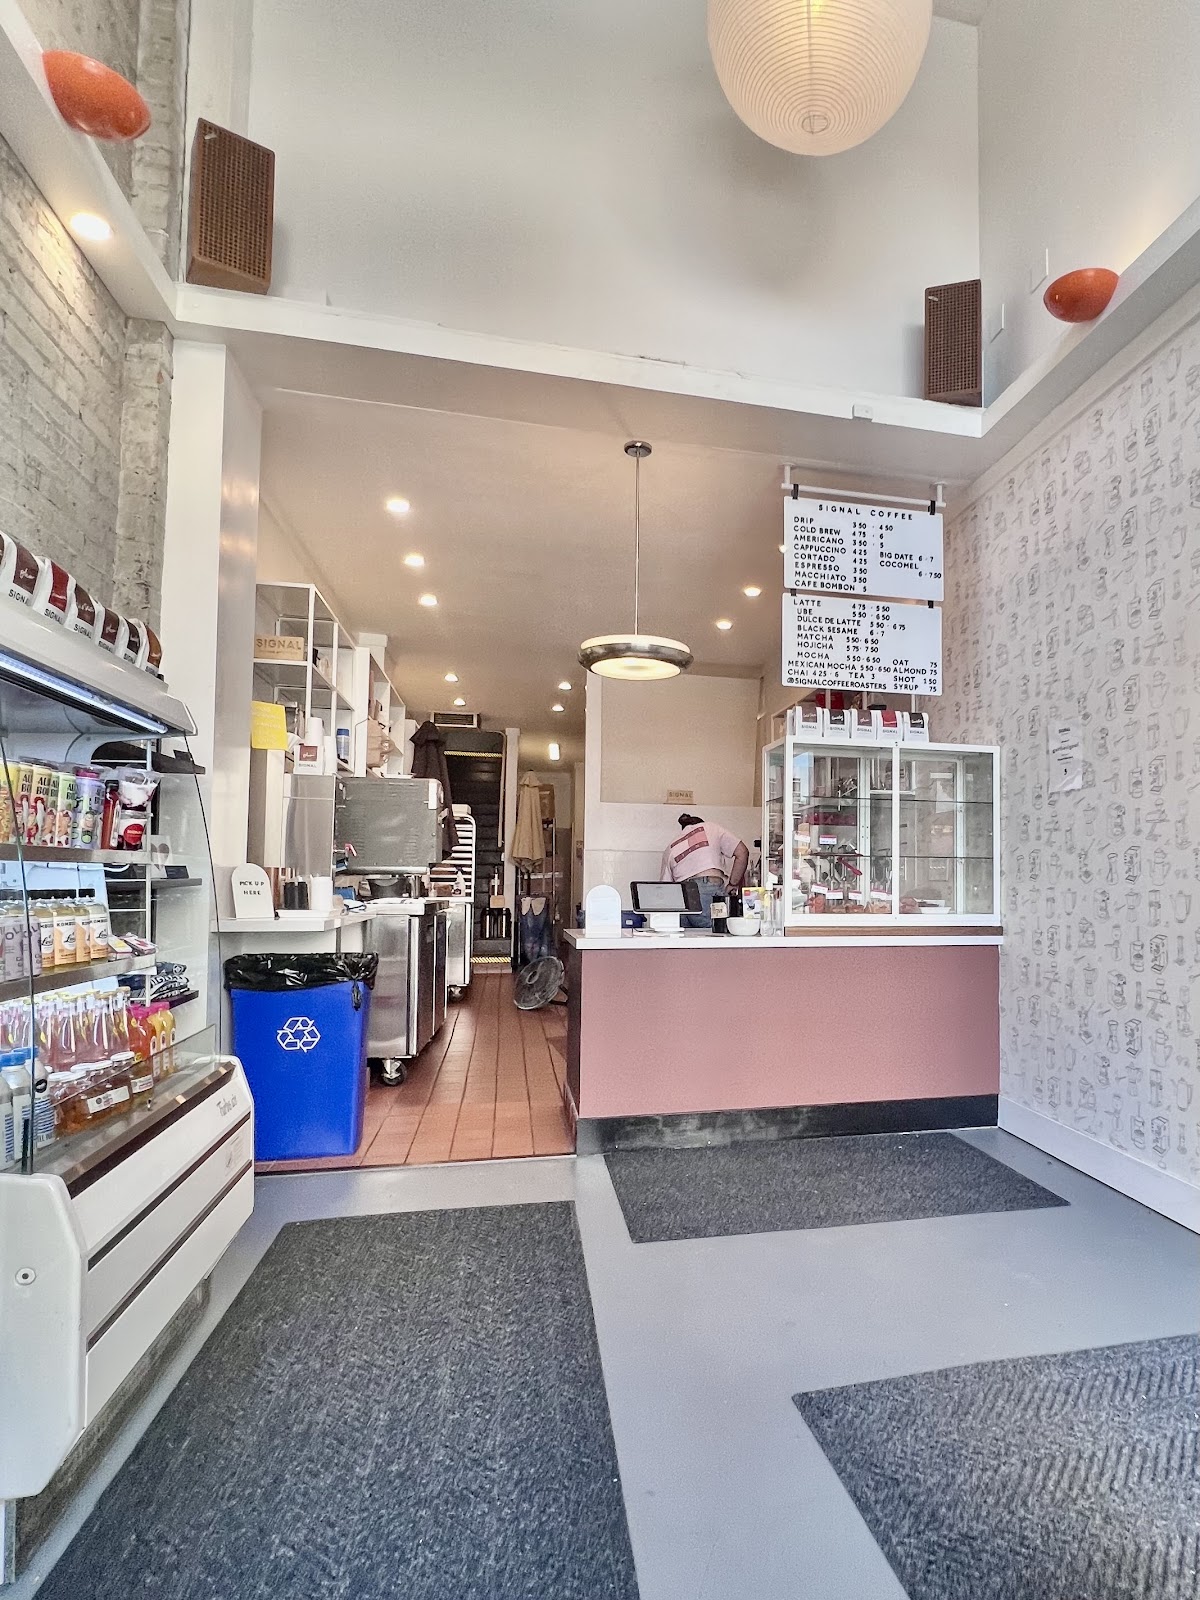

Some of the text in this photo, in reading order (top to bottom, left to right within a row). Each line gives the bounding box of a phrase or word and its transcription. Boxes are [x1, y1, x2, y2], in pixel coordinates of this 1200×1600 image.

[819, 505, 913, 520] SIGNAL COFFEE
[794, 525, 816, 533] COLD
[819, 528, 840, 536] BREW
[794, 535, 844, 544] AMERICANO
[794, 544, 846, 554] CAPPUCCINO
[794, 553, 835, 562] CORTADO
[894, 553, 913, 561] DATE
[795, 562, 839, 571] ESPRESSO
[880, 561, 918, 569] COCOMEL
[795, 571, 846, 581] MACCHIATO
[820, 582, 855, 591] BOMBON
[828, 627, 858, 635] SESAME
[256, 638, 302, 650] SIGNAL
[798, 642, 834, 650] HOJICHA
[797, 652, 830, 660] MOCHA
[788, 660, 825, 669] MEXICAN
[893, 667, 926, 675] ALMOND
